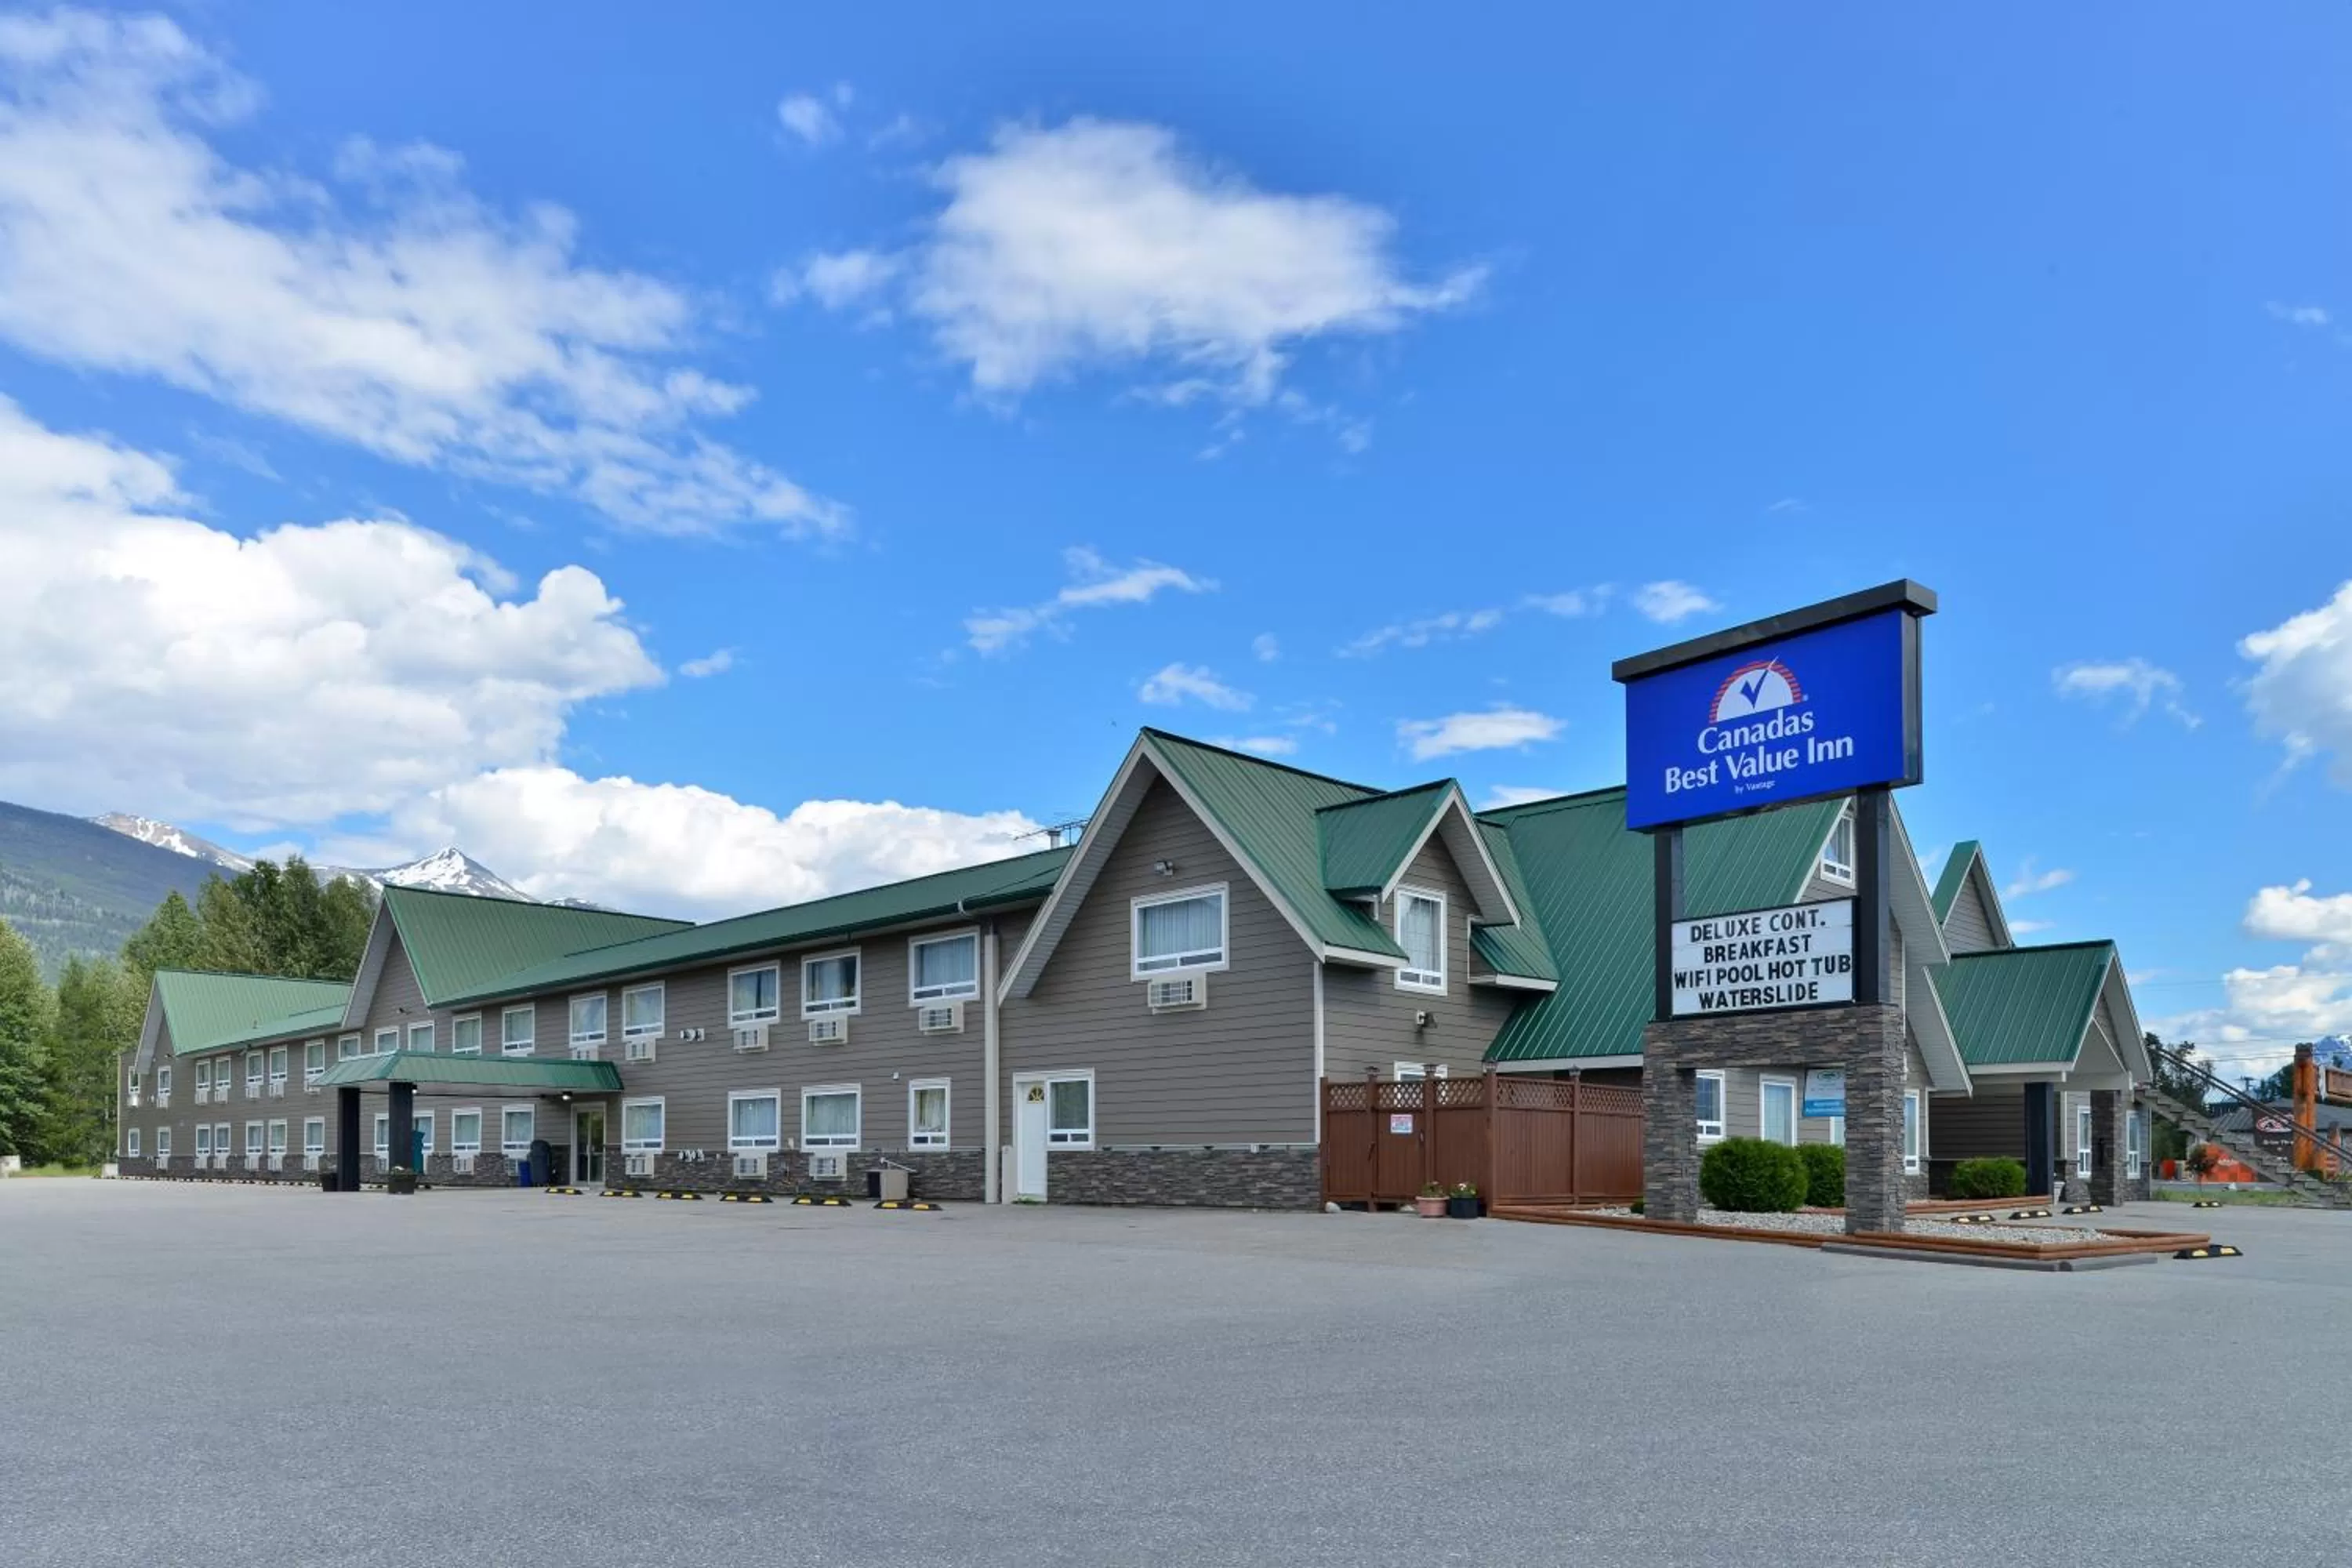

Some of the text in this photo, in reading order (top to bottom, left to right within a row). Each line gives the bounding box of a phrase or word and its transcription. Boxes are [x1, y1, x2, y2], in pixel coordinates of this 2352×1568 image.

[1697, 708, 1814, 754] Canadas
[1665, 736, 1853, 794] Best Value Inn
[1690, 909, 1826, 942] DELUXE CONT.
[1704, 934, 1812, 964] BREAKFAST
[1674, 954, 1851, 989] WIFI POOL HOT TUB
[1698, 982, 1818, 1009] WATERSLIDE
